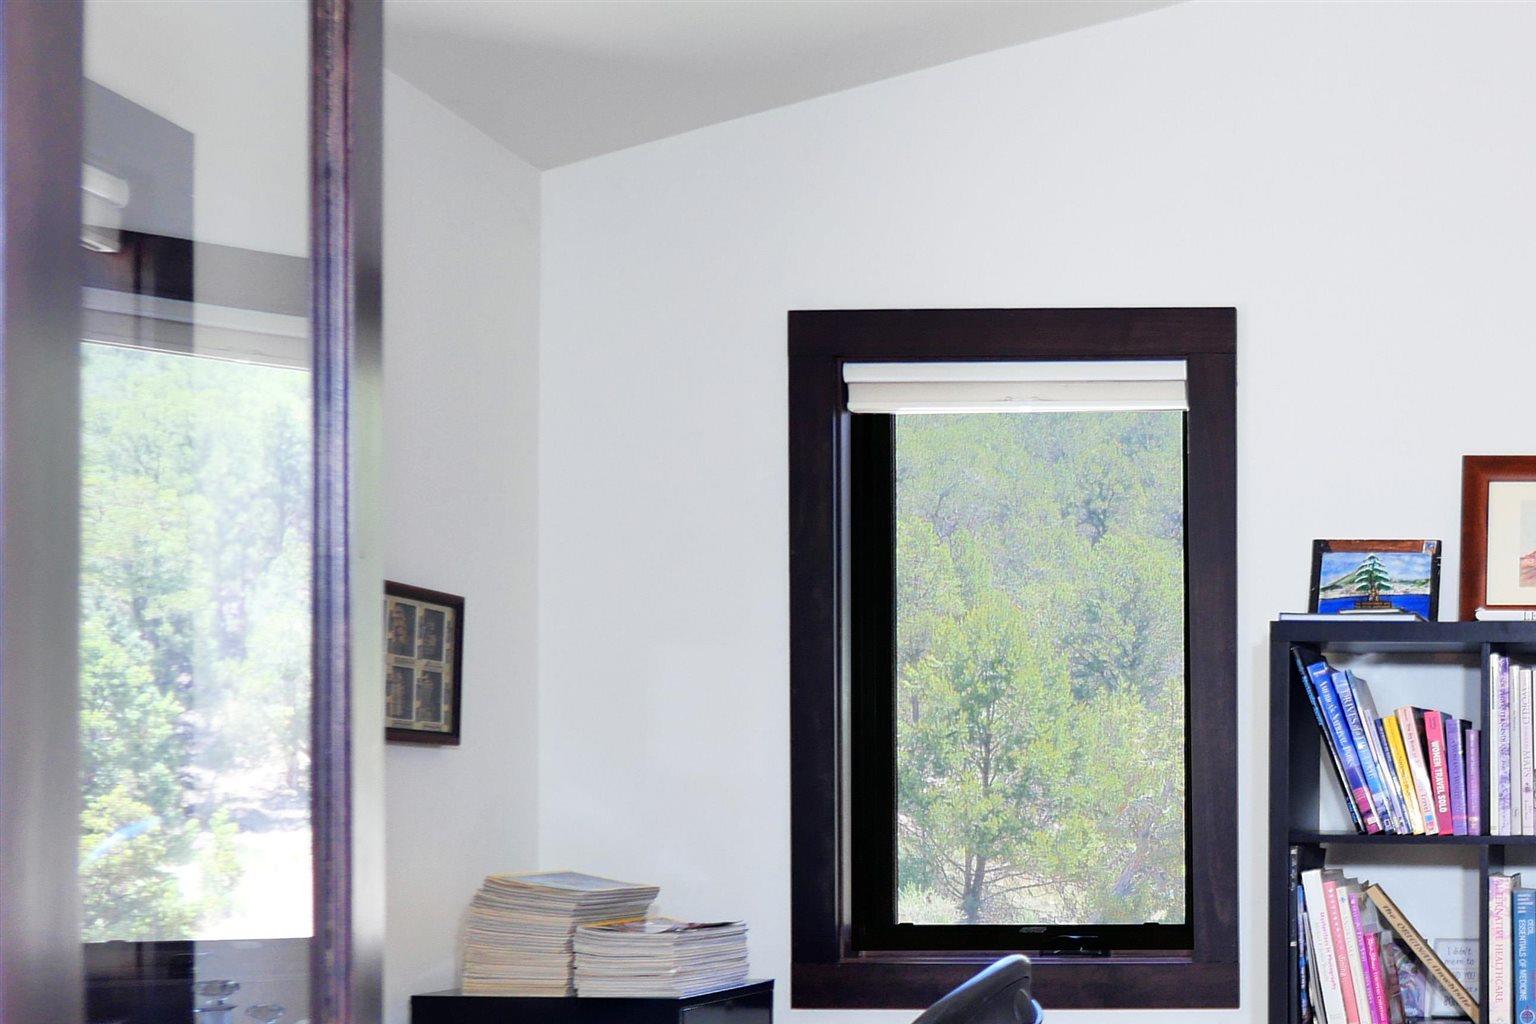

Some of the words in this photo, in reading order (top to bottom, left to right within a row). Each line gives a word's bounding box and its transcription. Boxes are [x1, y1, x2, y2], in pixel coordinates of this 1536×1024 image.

[1431, 740, 1440, 767] WOMEN
[1434, 769, 1444, 794] TRAVEL
[1438, 795, 1447, 813] SOLO
[1518, 919, 1526, 957] ESSENTIALS
[1495, 944, 1504, 1003] HEALTHCARE
[1519, 959, 1526, 968] OF
[1519, 970, 1527, 1001] MEDICINE
